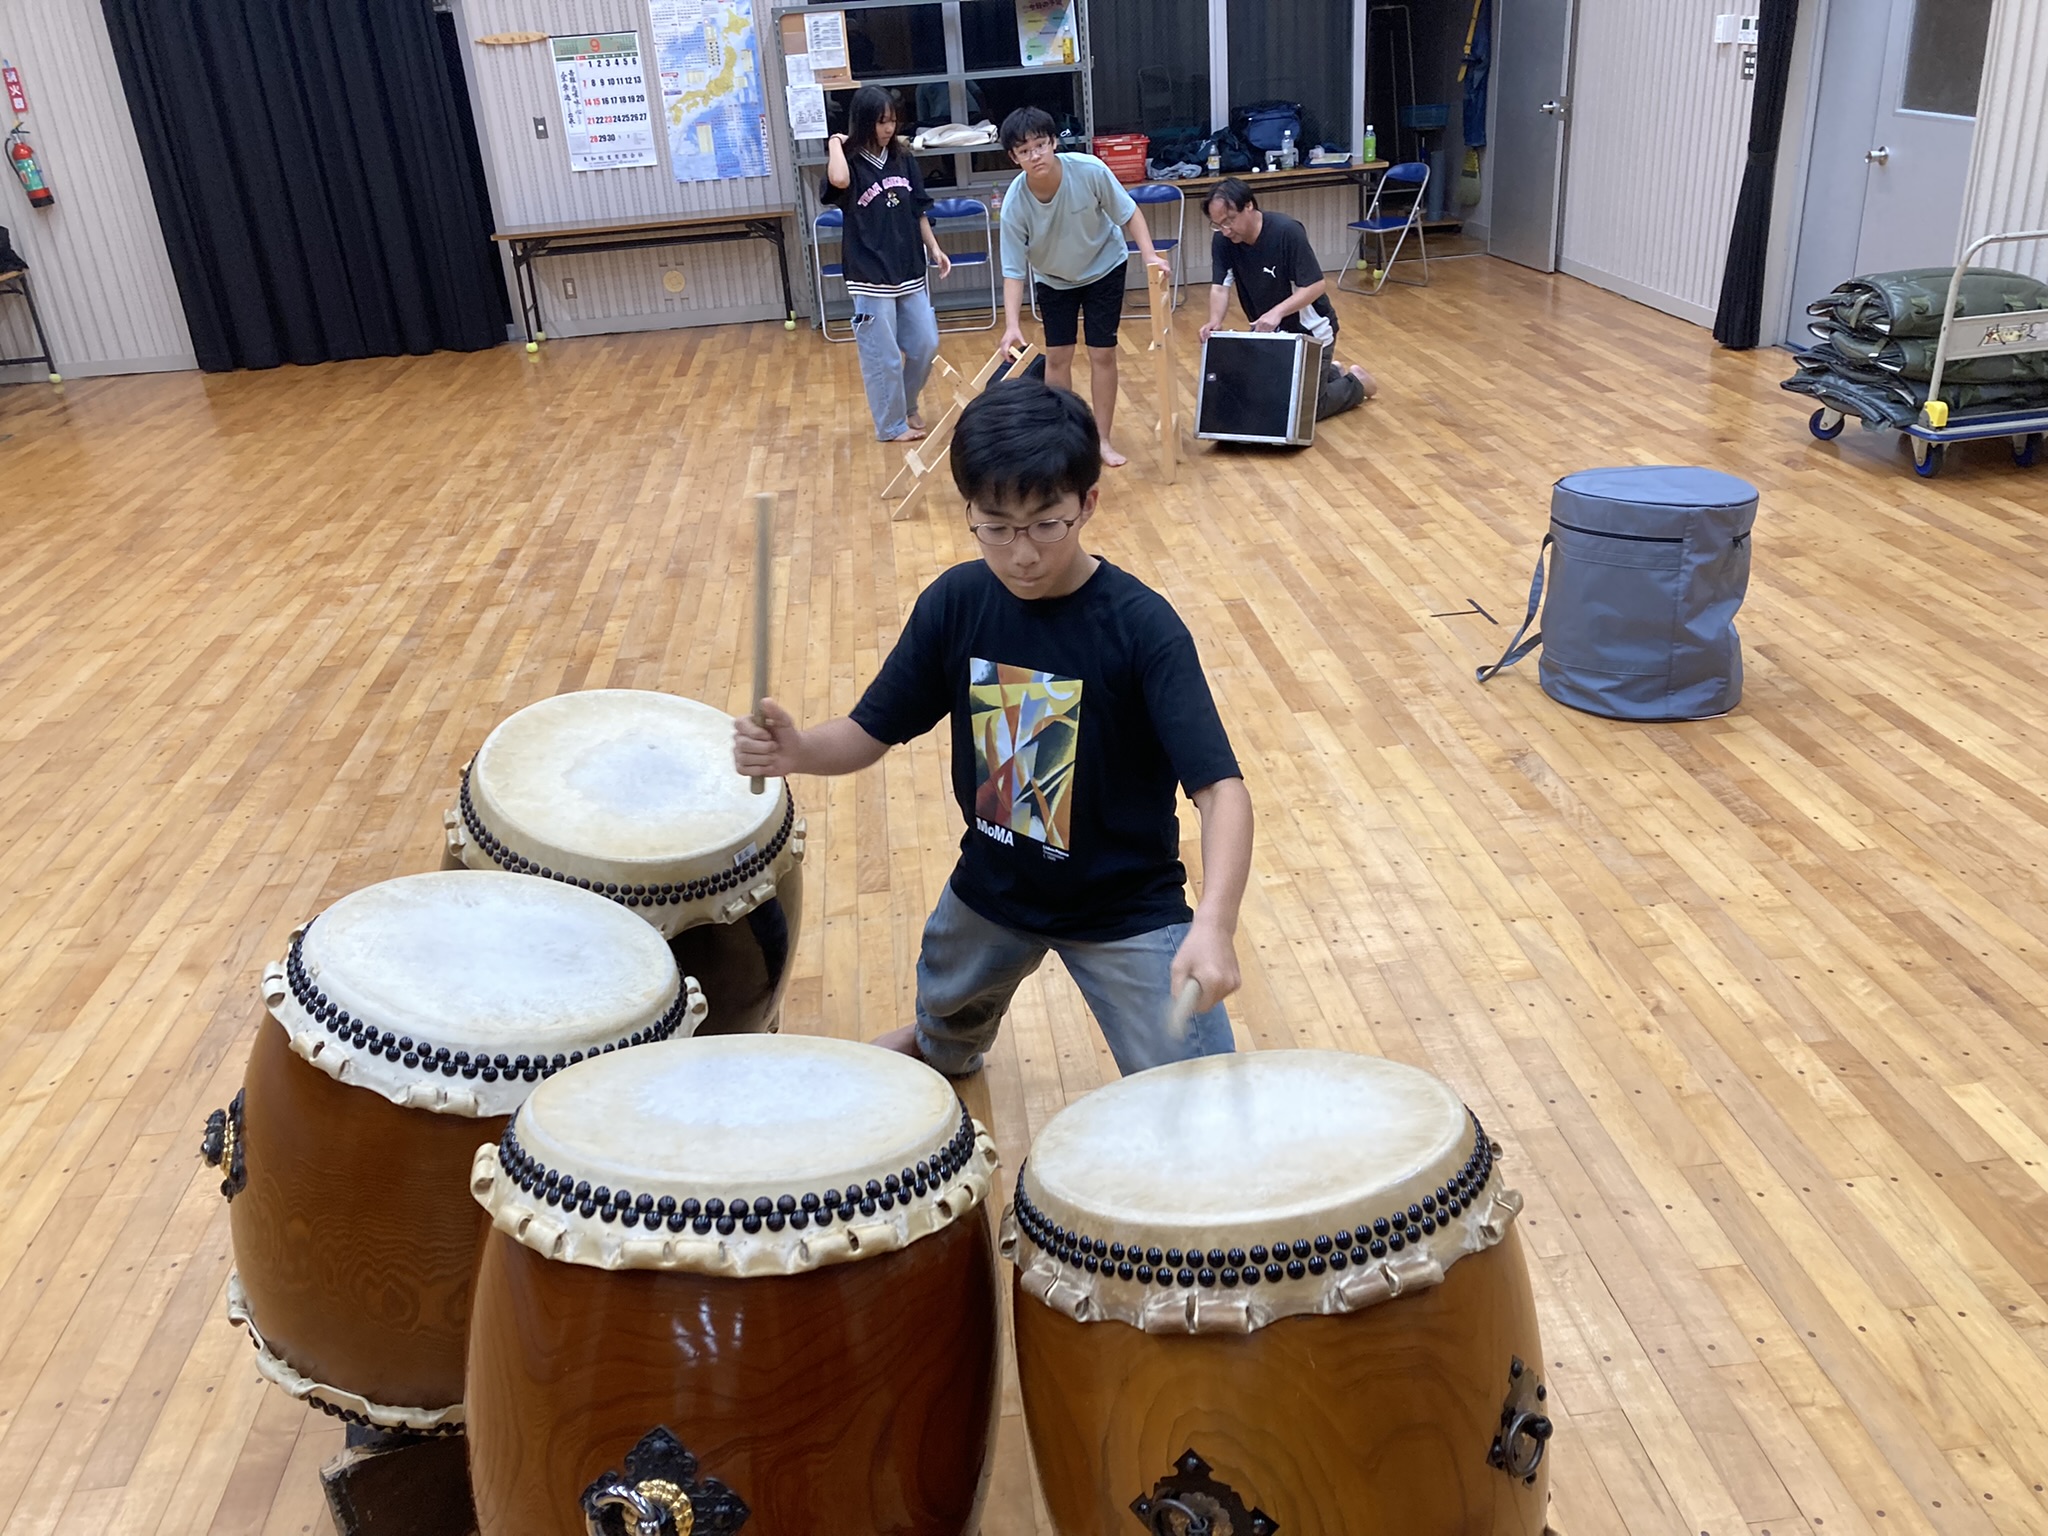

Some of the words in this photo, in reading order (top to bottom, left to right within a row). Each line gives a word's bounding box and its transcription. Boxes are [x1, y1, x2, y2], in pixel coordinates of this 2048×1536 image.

[589, 38, 601, 52] 9
[616, 77, 624, 85] 11
[634, 76, 641, 84] 13
[601, 97, 609, 105] 16
[610, 96, 617, 104] 17
[619, 96, 627, 104] 18
[628, 95, 636, 103] 19
[636, 94, 645, 102] 20
[587, 117, 595, 125] 21
[596, 116, 604, 124] 22
[604, 116, 613, 124] 23
[613, 115, 621, 123] 24
[622, 114, 630, 122] 25
[639, 113, 647, 121] 27
[607, 134, 616, 142] 30
[857, 181, 883, 207] TEAM
[975, 817, 1014, 847] MoMA
